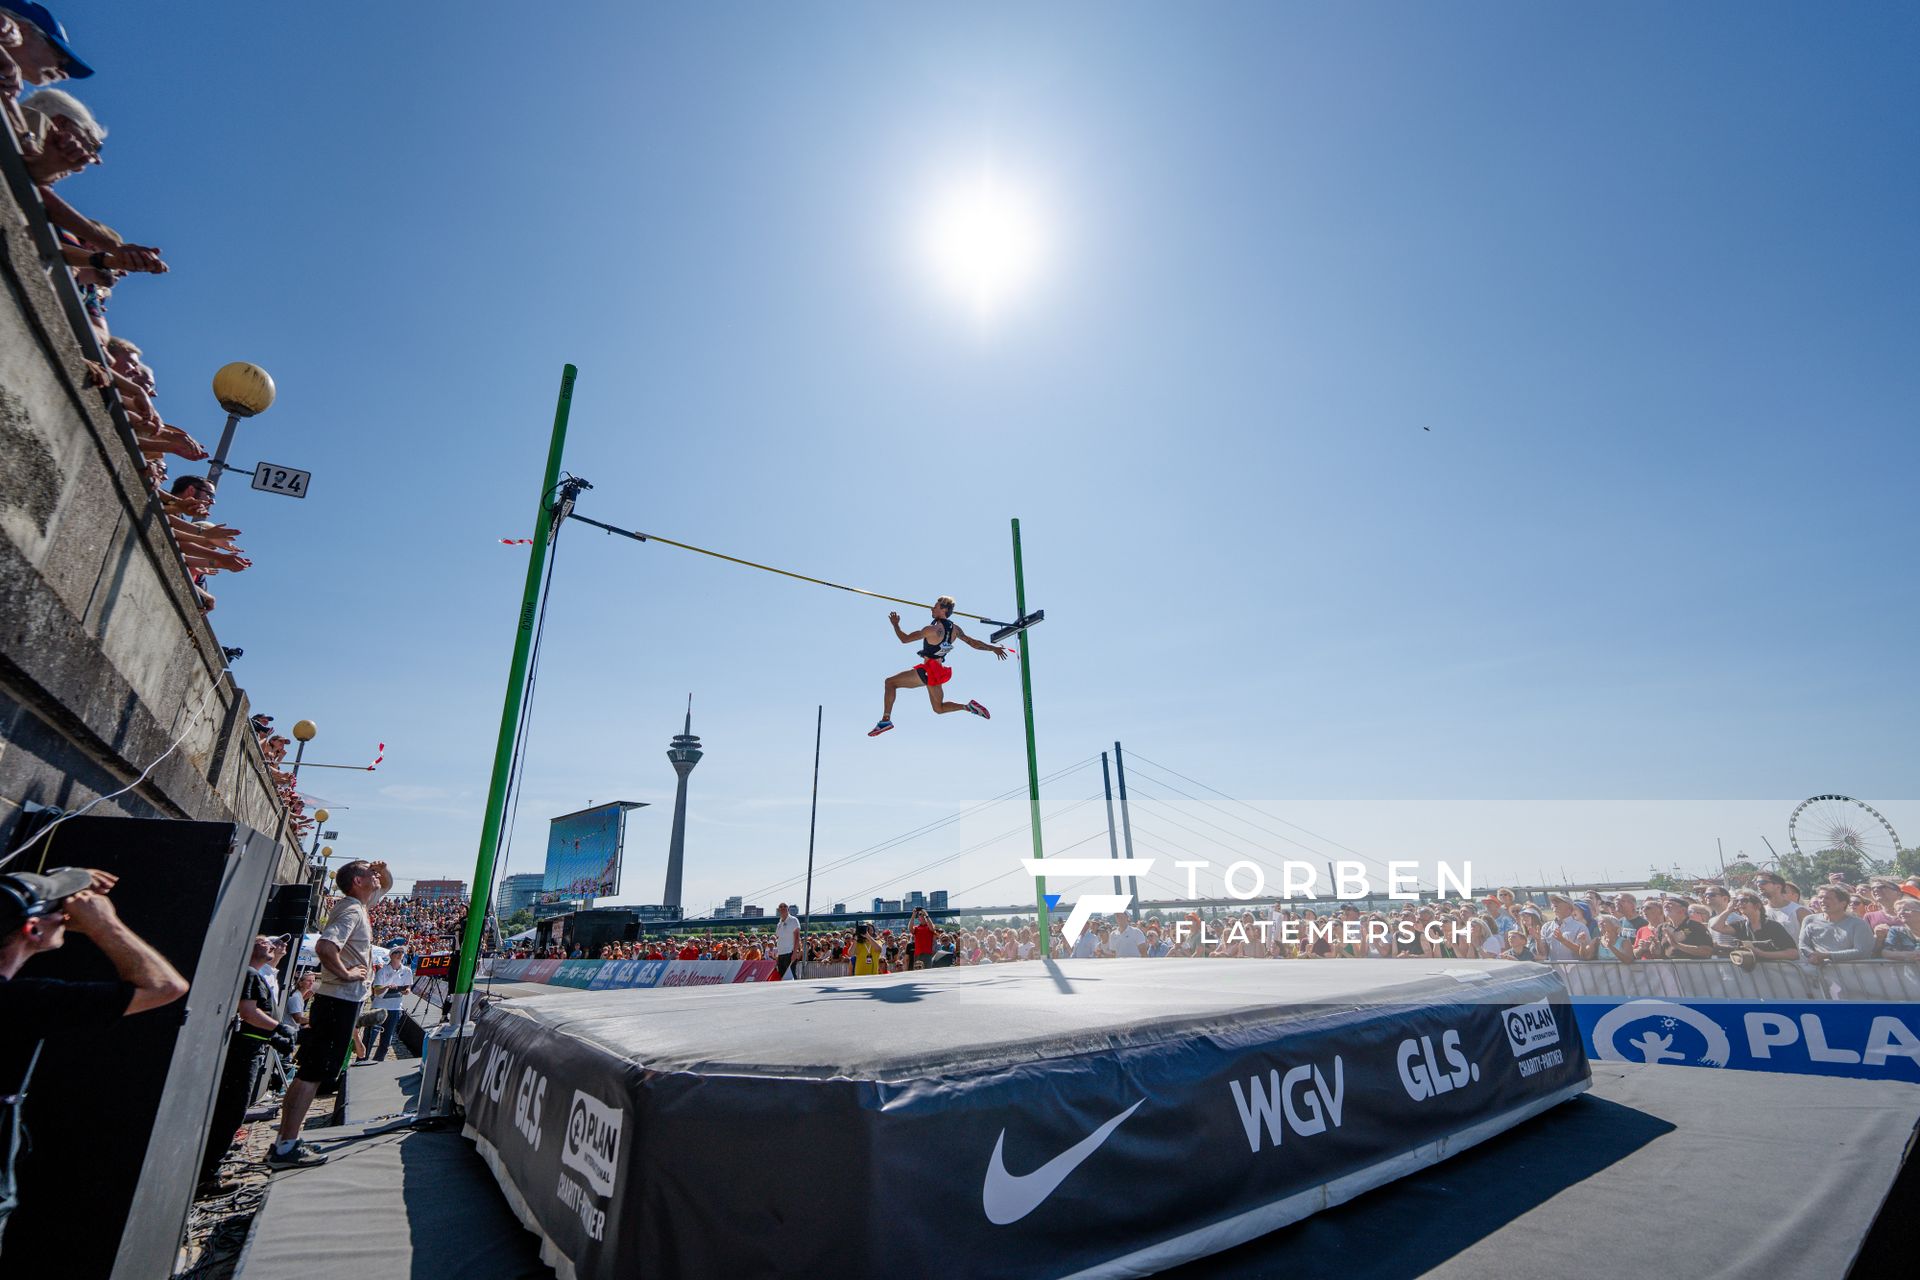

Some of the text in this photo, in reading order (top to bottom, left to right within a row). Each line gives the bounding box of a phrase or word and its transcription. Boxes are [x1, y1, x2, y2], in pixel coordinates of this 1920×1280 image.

[262, 467, 301, 493] 124
[522, 601, 536, 630] VINDICO
[421, 957, 451, 967] 0:43
[1524, 1008, 1554, 1031] PLAN
[1531, 1031, 1557, 1042] INTERNATIONAL
[1744, 1012, 1920, 1067] PLA
[481, 1044, 514, 1104] WGV
[1397, 1029, 1480, 1101] GLS.
[1519, 1049, 1564, 1077] CHARITY-PARTNER
[514, 1065, 548, 1152] GLS.
[1229, 1055, 1344, 1153] WGV
[586, 1113, 617, 1164] PLAN
[556, 1172, 606, 1242] CHARITY-PER
